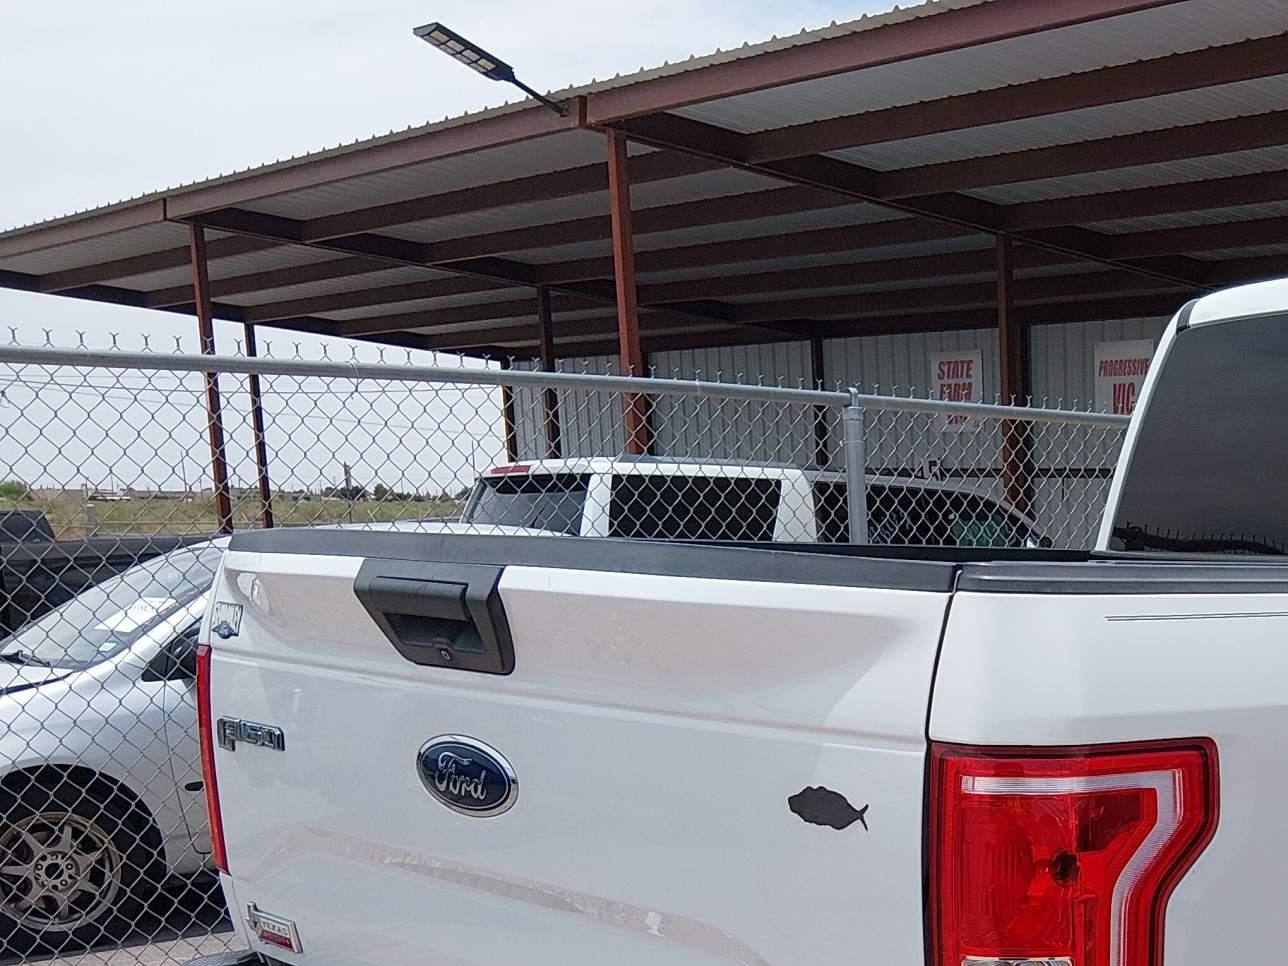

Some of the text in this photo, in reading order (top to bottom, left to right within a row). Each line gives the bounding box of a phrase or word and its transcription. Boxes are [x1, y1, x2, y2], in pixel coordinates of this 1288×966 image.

[937, 359, 974, 380] STATE
[1098, 358, 1150, 377] PROGRESSIVE
[939, 382, 973, 401] FARM
[434, 751, 487, 800] Ford
[261, 920, 289, 936] TEXAS
